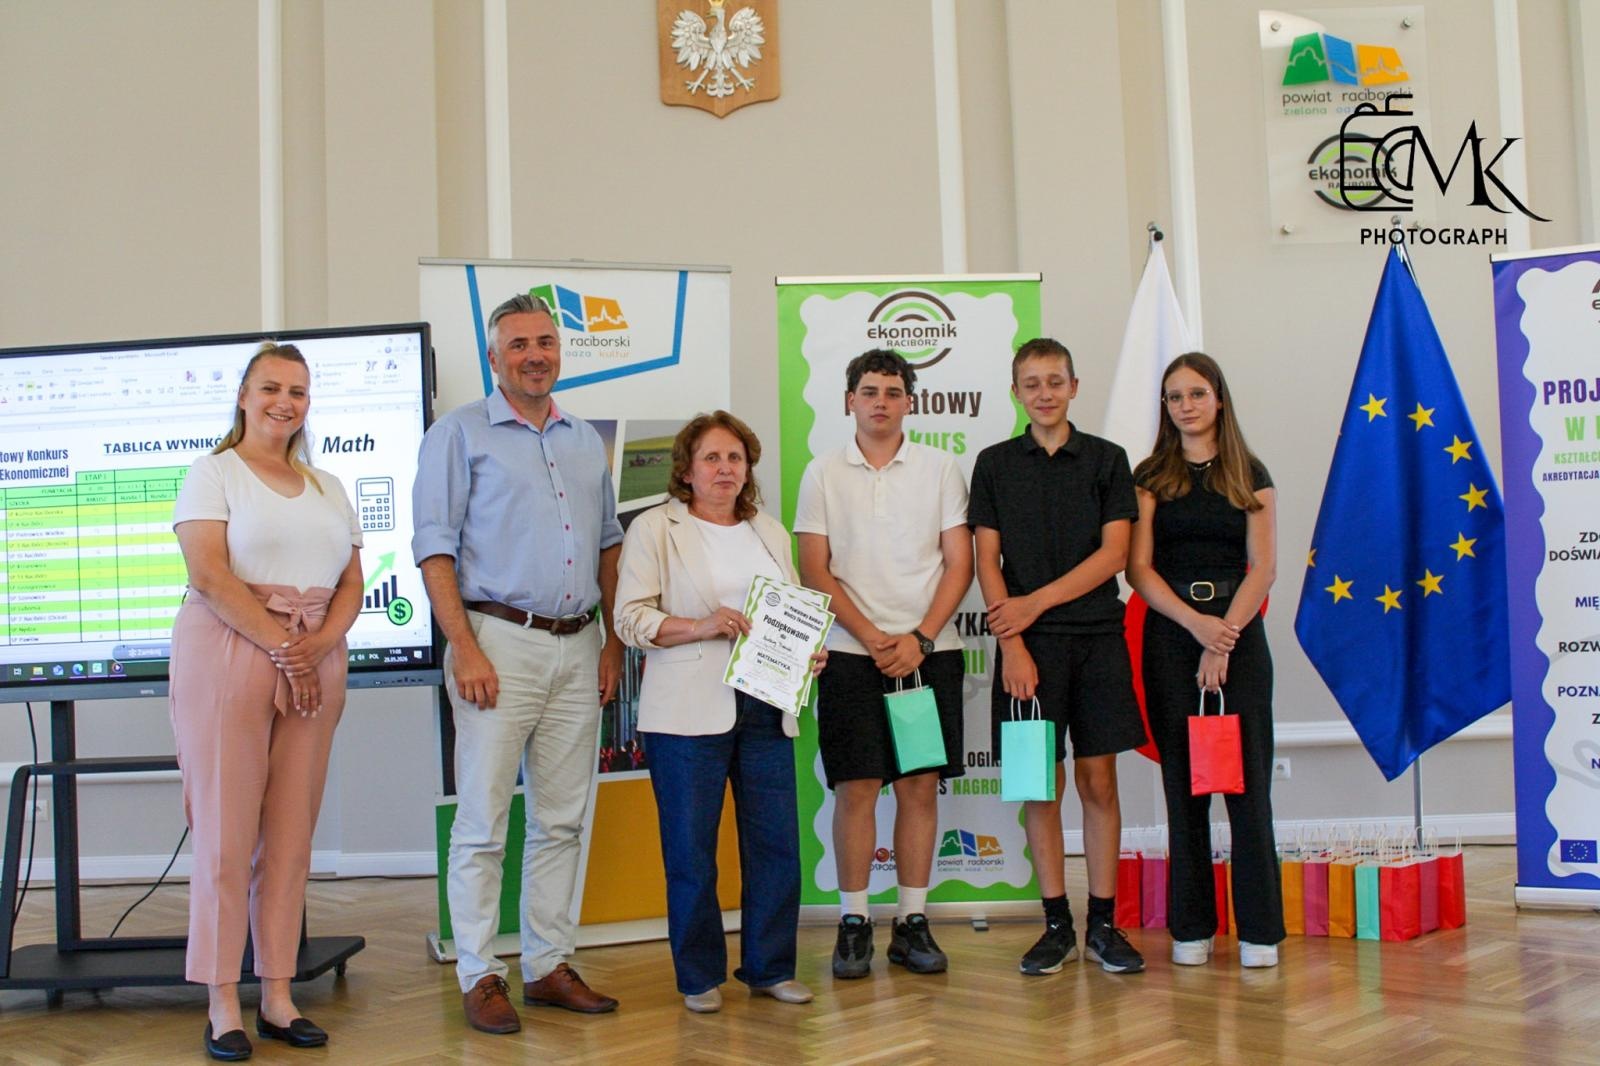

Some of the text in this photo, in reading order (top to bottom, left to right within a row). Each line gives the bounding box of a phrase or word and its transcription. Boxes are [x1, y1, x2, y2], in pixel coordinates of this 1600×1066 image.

[1282, 90, 1332, 107] powiat
[570, 335, 630, 348] raciborski
[1564, 415, 1585, 442] W
[104, 441, 162, 454] TABLICA
[322, 433, 375, 454] Math
[27, 448, 69, 461] Konkurs
[1554, 451, 1600, 464] KSZTAŁC
[0, 465, 69, 480] Ekonomicznej
[1542, 470, 1599, 482] AKREDYTACJA
[1579, 532, 1600, 543] ZD
[1558, 686, 1600, 697] POZN
[953, 778, 1001, 796] NAGRO
